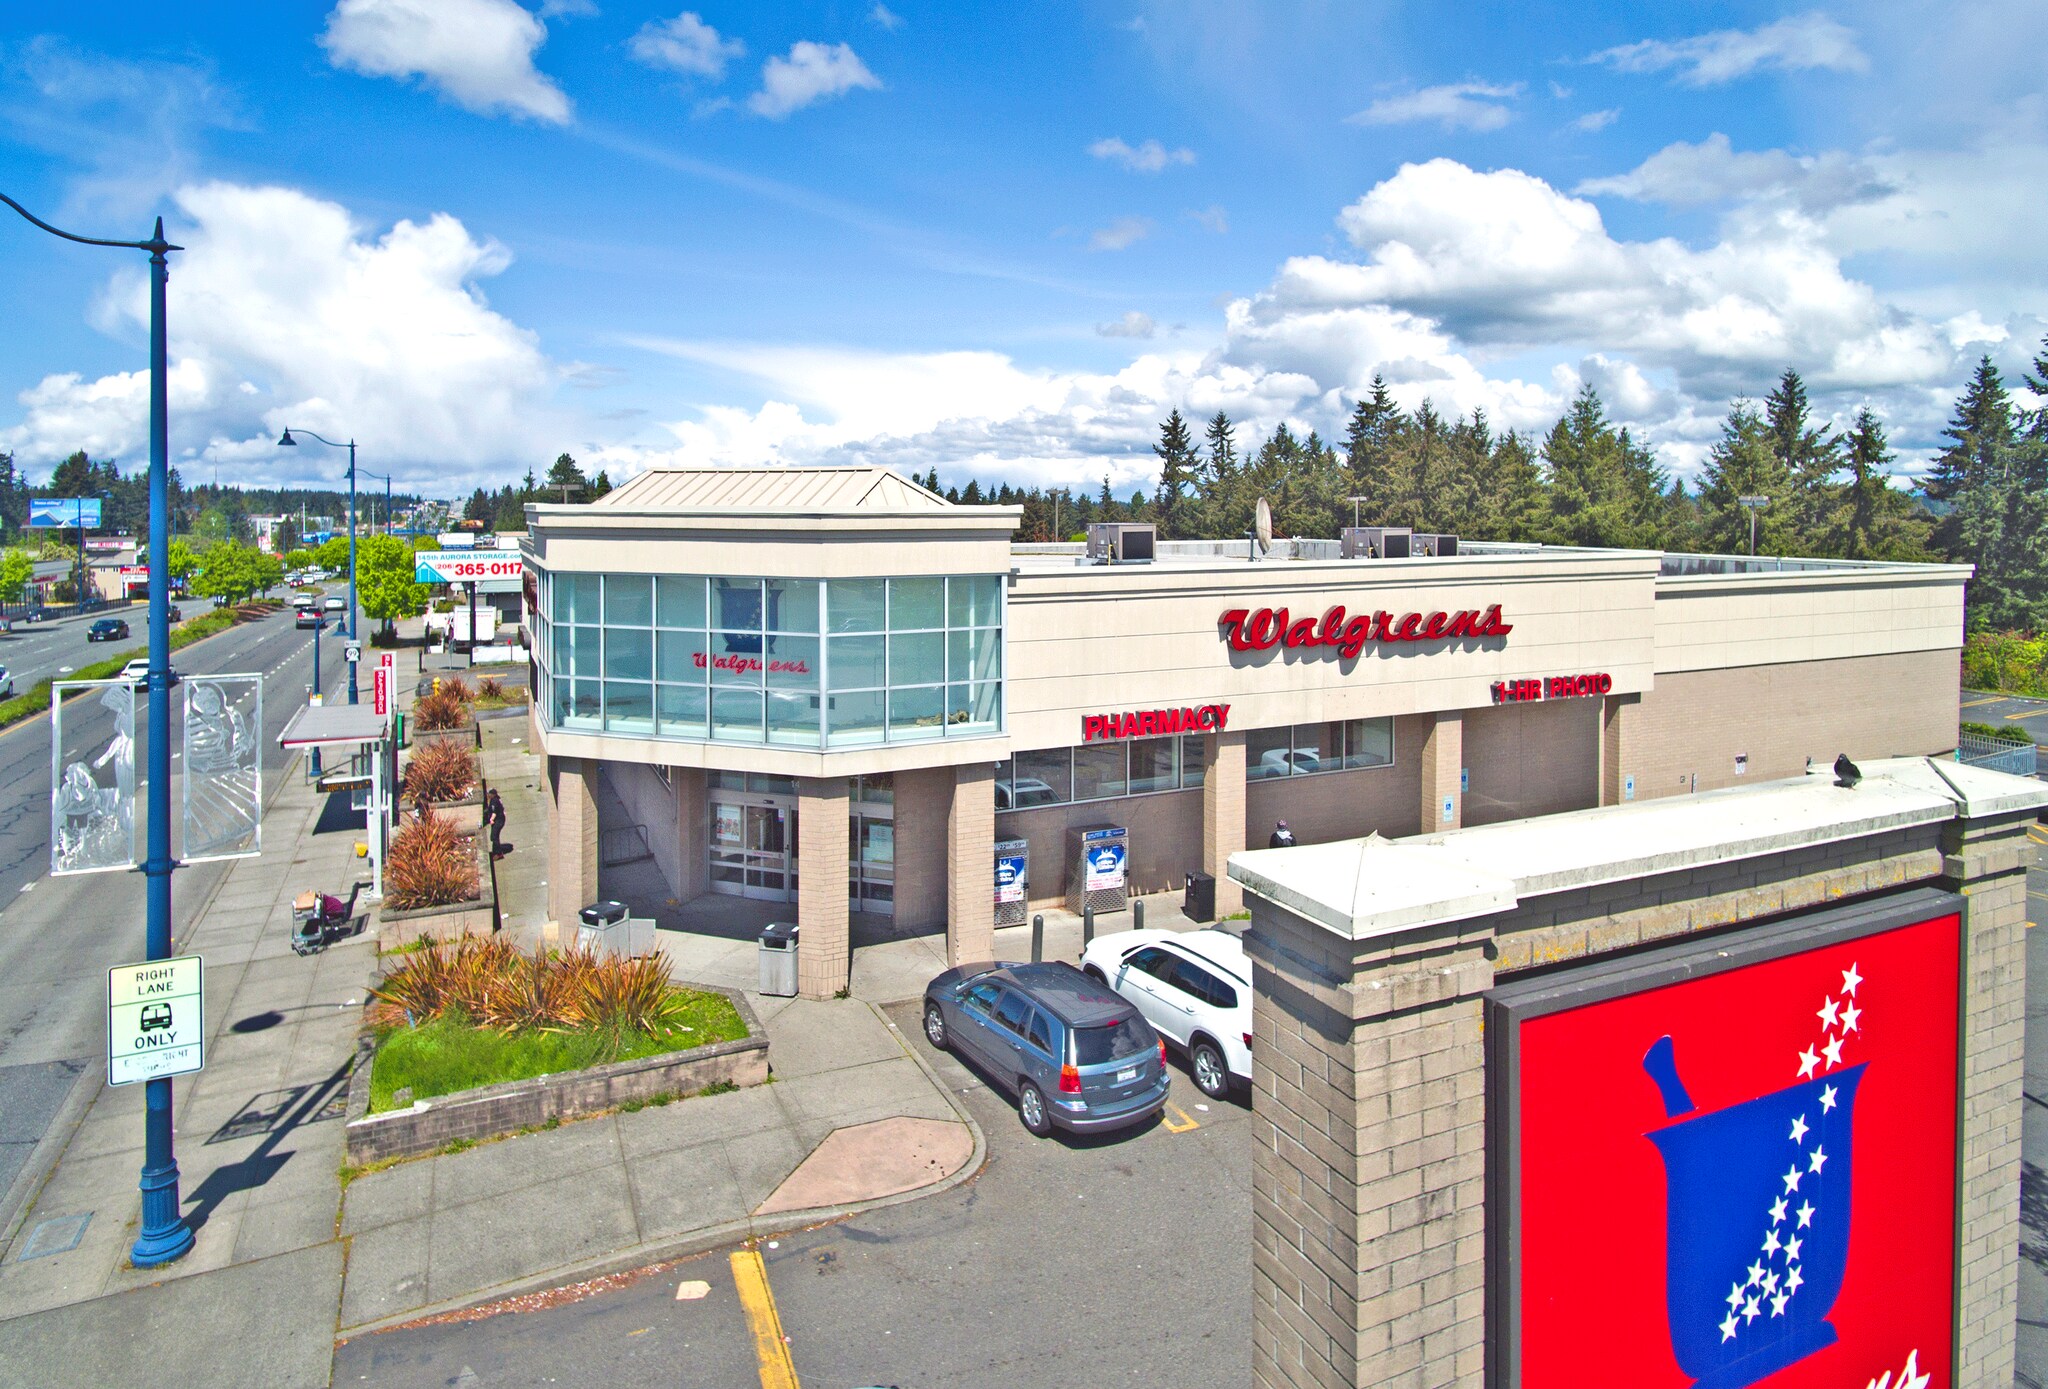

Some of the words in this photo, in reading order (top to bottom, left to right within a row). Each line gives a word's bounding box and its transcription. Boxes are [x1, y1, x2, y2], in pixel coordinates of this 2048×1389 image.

[454, 562, 522, 576] 365-0117
[1218, 604, 1513, 659] Walgreens
[349, 650, 357, 658] 99
[1491, 681, 1542, 703] 1-HR
[1546, 672, 1612, 699] PHOTO
[1082, 704, 1231, 742] PHARMACY
[136, 967, 175, 982] RIGHT
[138, 981, 174, 995] LANE
[135, 1031, 178, 1050] ONLY
